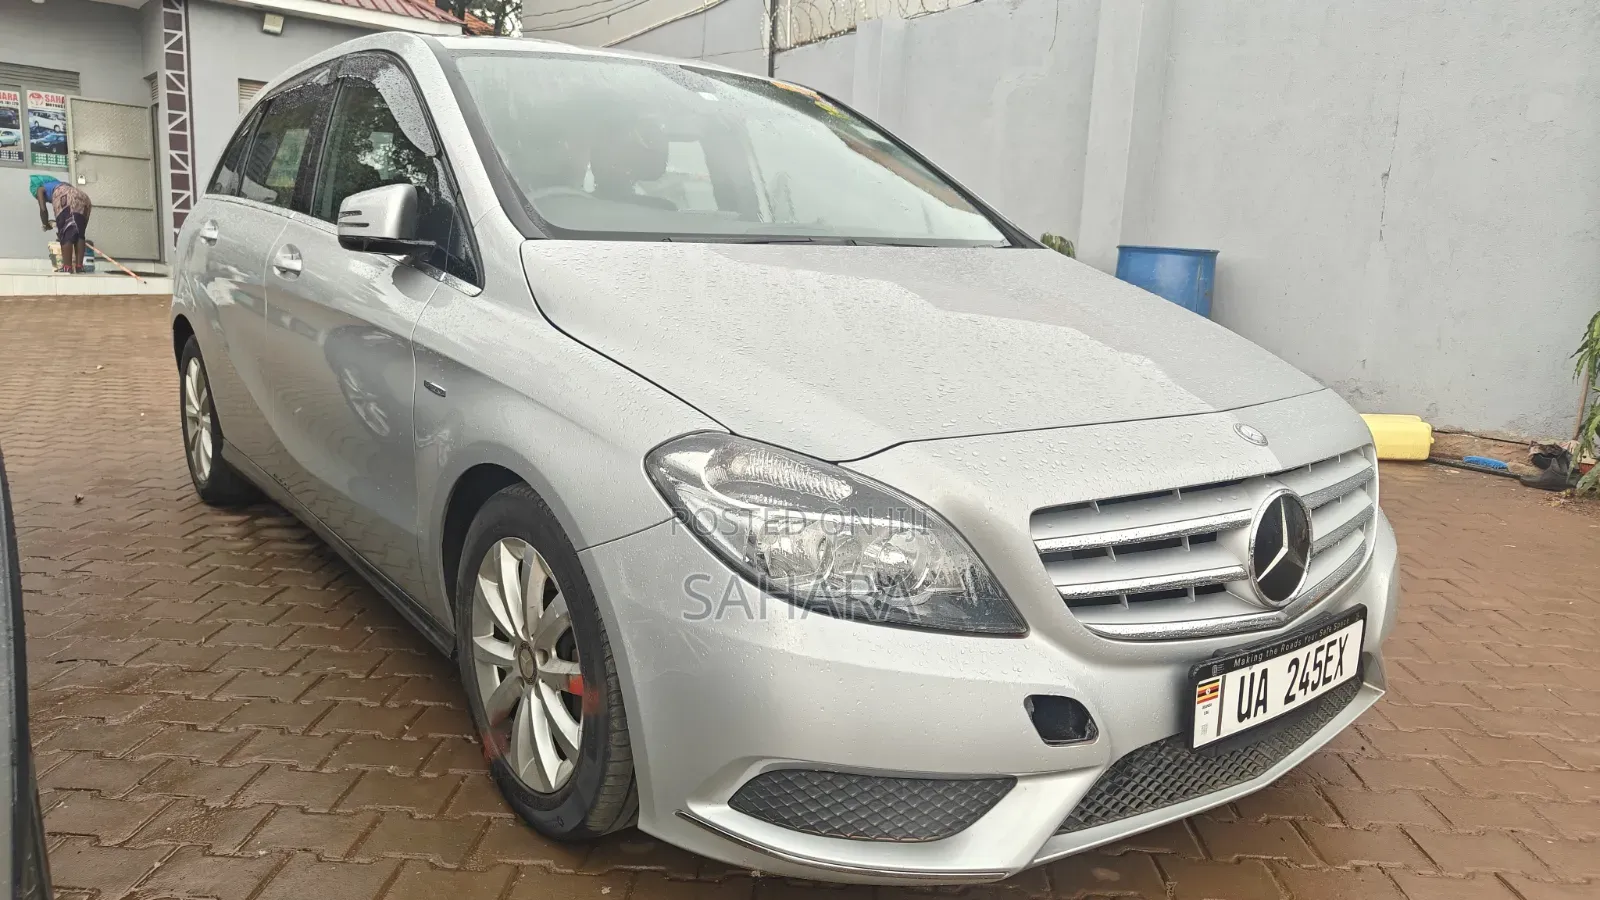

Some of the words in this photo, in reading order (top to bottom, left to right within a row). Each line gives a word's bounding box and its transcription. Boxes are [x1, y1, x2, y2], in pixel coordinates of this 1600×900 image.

[0, 92, 18, 101] ARA
[1233, 652, 1263, 668] Making
[1265, 647, 1278, 658] the
[1280, 638, 1302, 653] Roads
[1304, 633, 1318, 644] Your
[1319, 625, 1332, 637] Safe
[1333, 618, 1350, 630] Space
[1237, 667, 1269, 723] UA
[1283, 633, 1349, 706] 245EX
